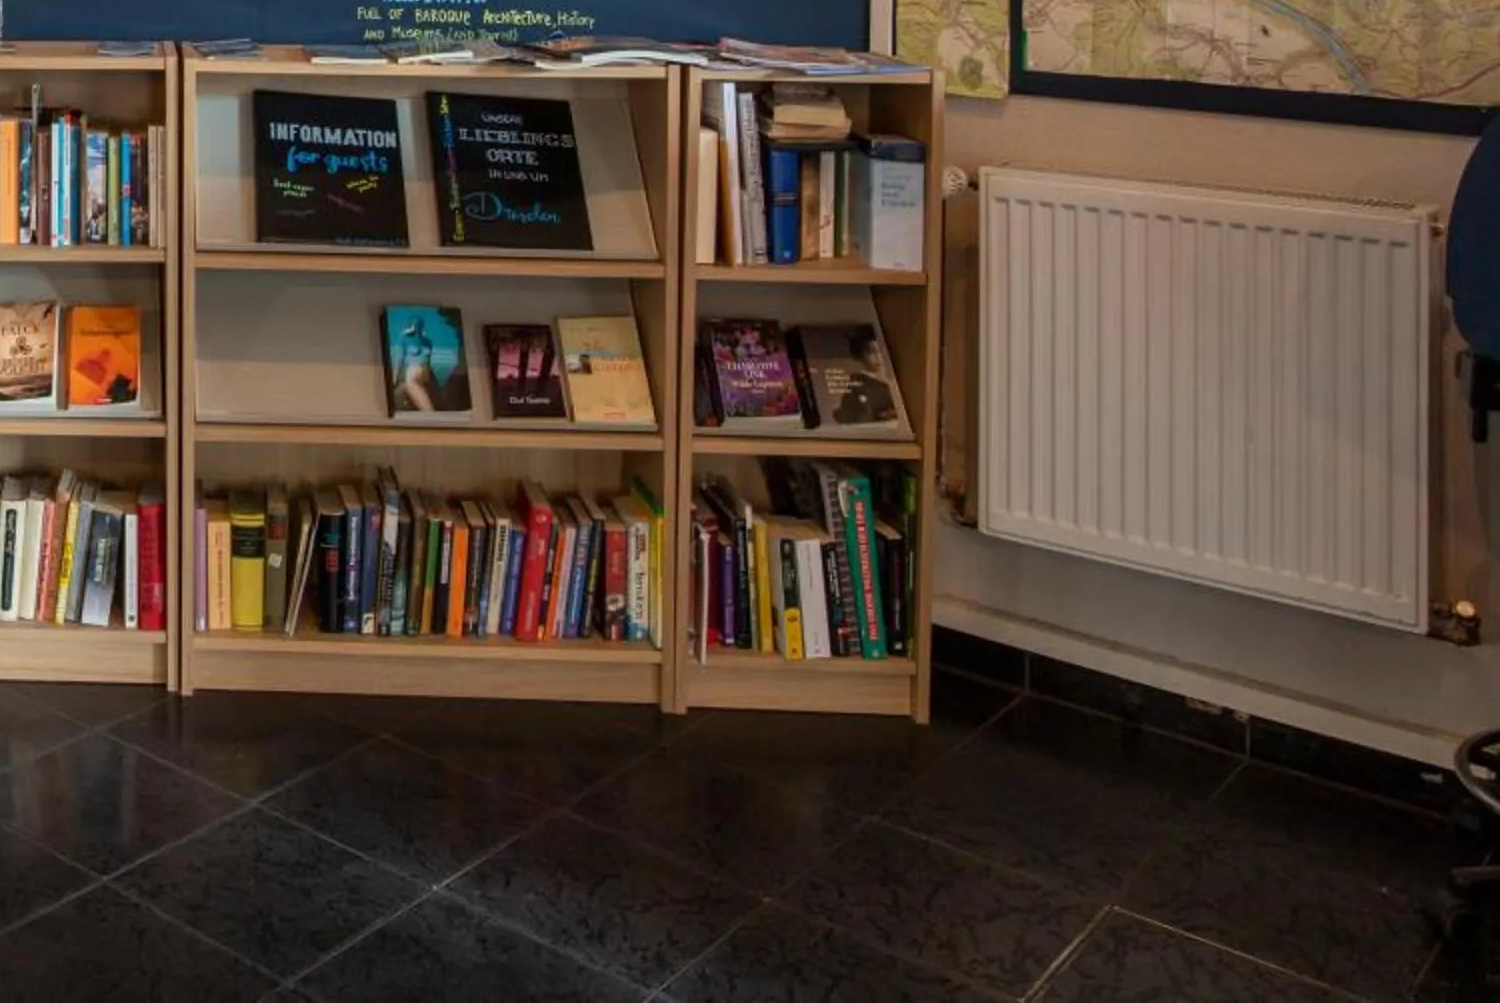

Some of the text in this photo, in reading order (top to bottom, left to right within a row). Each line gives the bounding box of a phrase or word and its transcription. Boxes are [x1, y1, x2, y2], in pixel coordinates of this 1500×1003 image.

[269, 122, 397, 148] INFORMATION
[458, 127, 575, 149] LIEBLINGS
[287, 145, 389, 175] for guests
[486, 147, 540, 166] ORTE
[461, 191, 562, 225] Dresden
